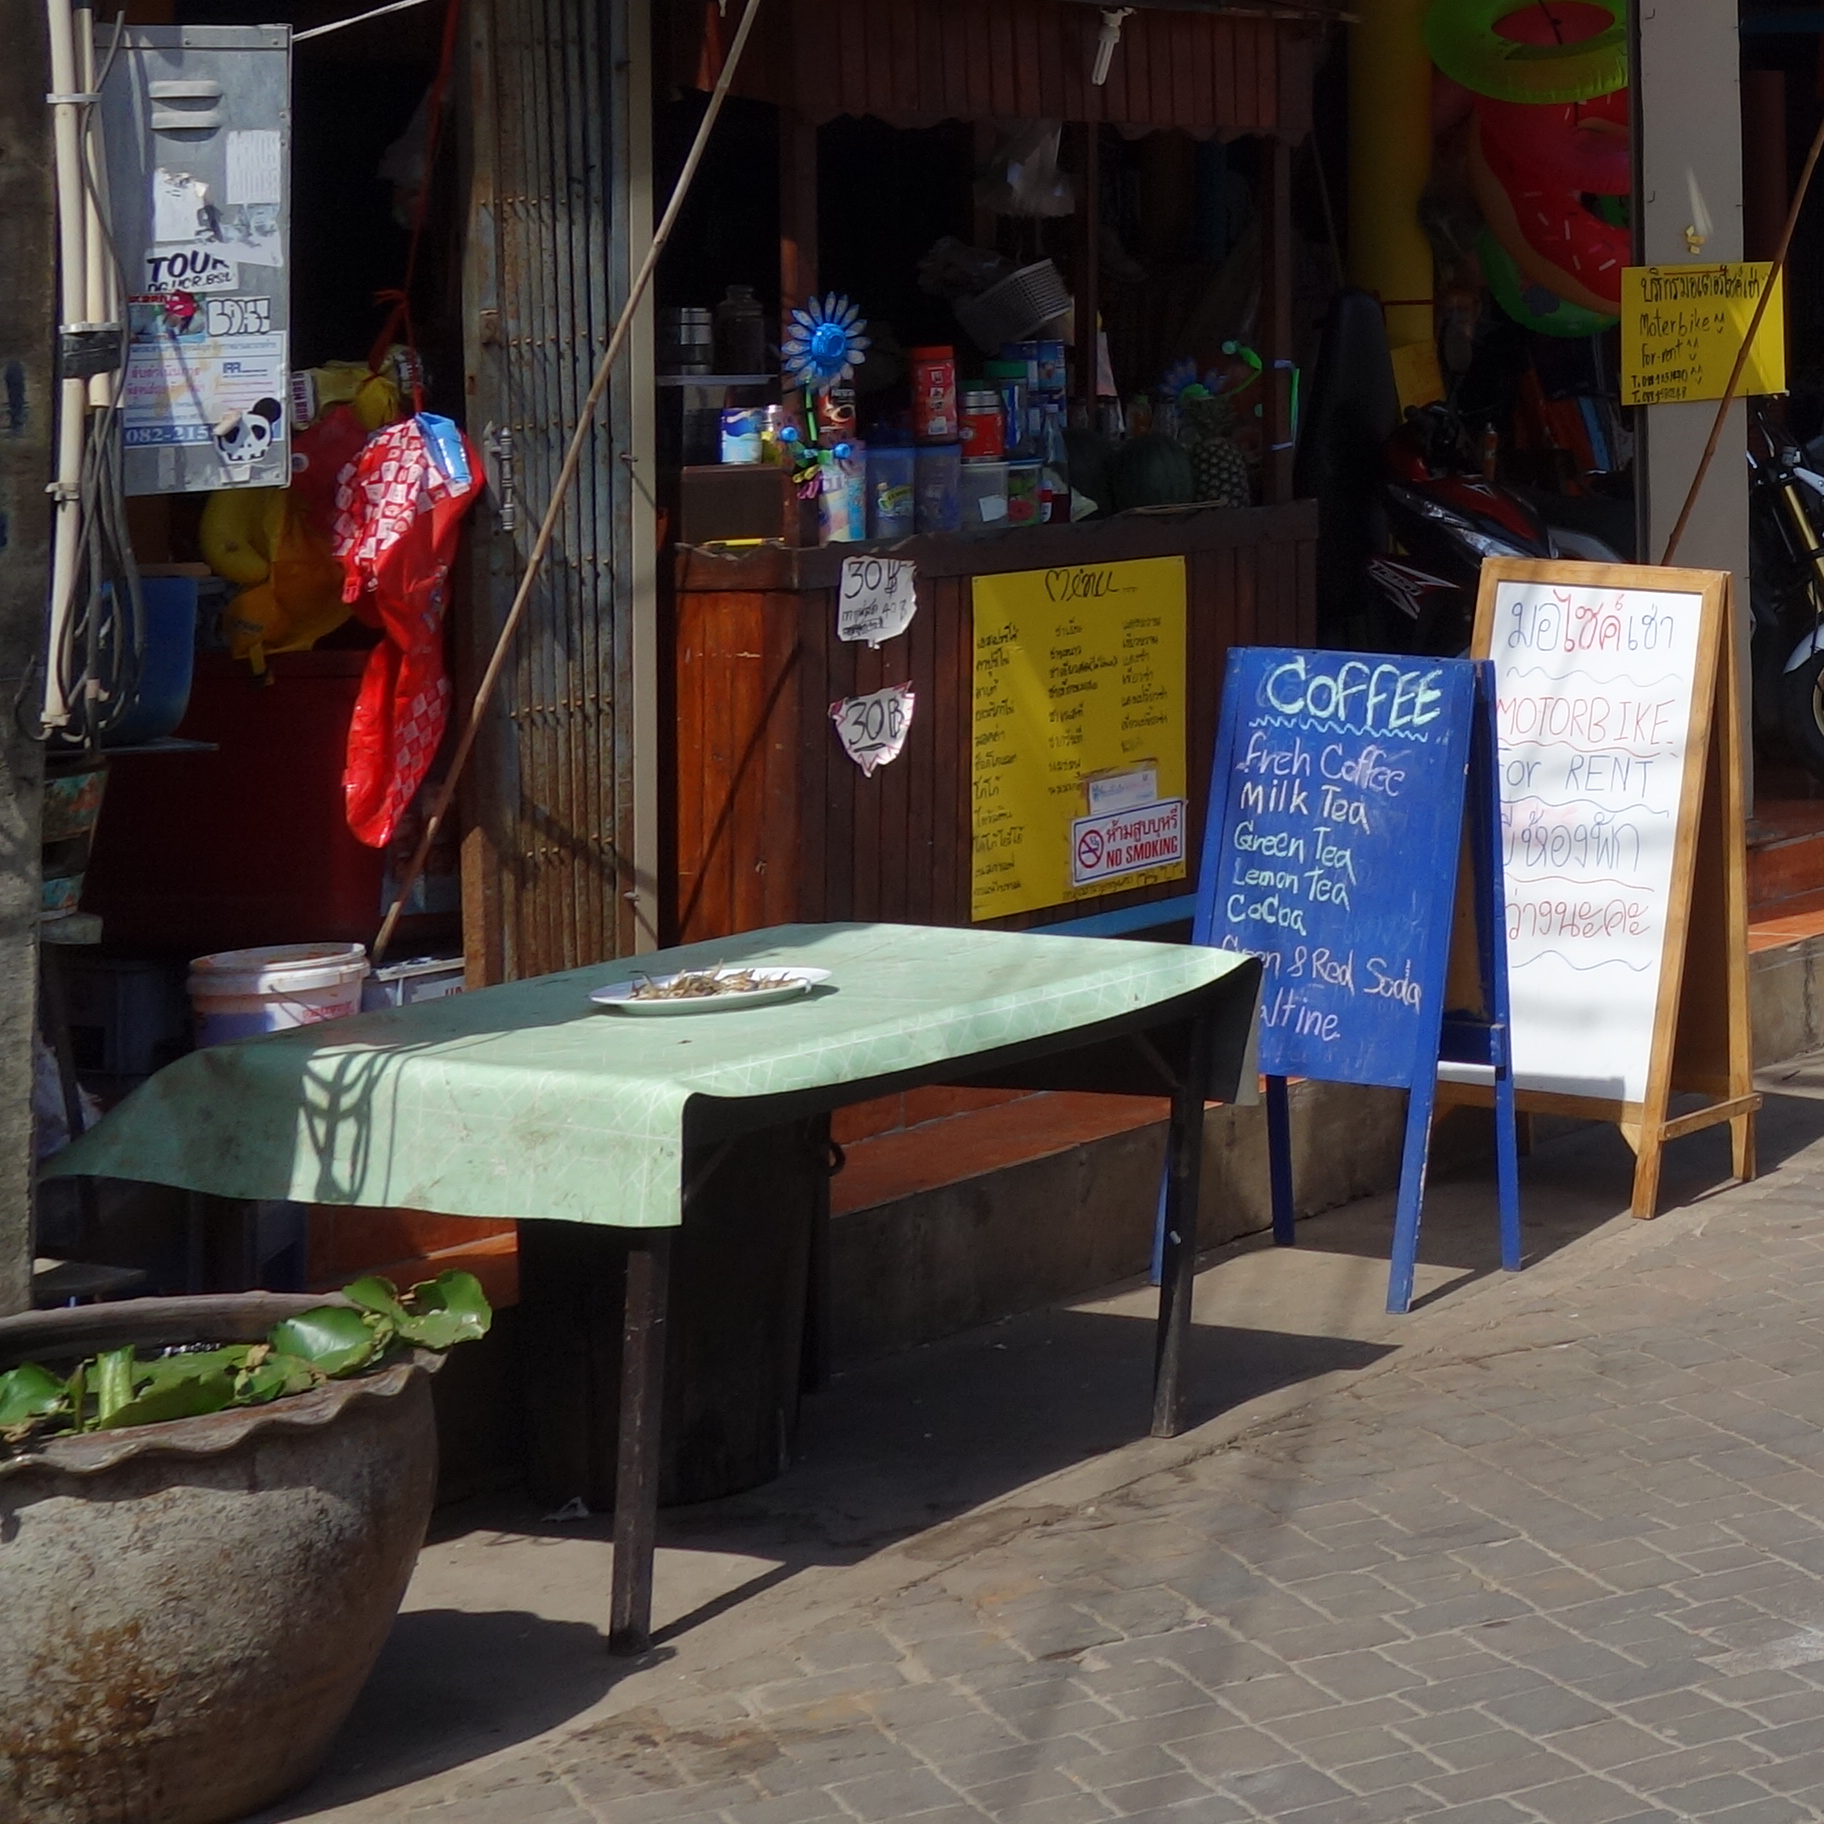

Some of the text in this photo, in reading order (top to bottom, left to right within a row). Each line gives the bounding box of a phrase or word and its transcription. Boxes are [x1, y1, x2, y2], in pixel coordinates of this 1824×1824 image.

[1565, 754, 1653, 798] RENT
[1106, 806, 1179, 843] ห้ามสูบบุหรี่
[1240, 778, 1370, 834] Milk Tea
[1106, 836, 1178, 869] NO SMOKING
[1234, 821, 1357, 886] Green Tea
[1232, 857, 1298, 894] Lemon
[1303, 866, 1350, 911] Tea
[1312, 948, 1355, 996] Red
[1364, 957, 1423, 1016] Soda
